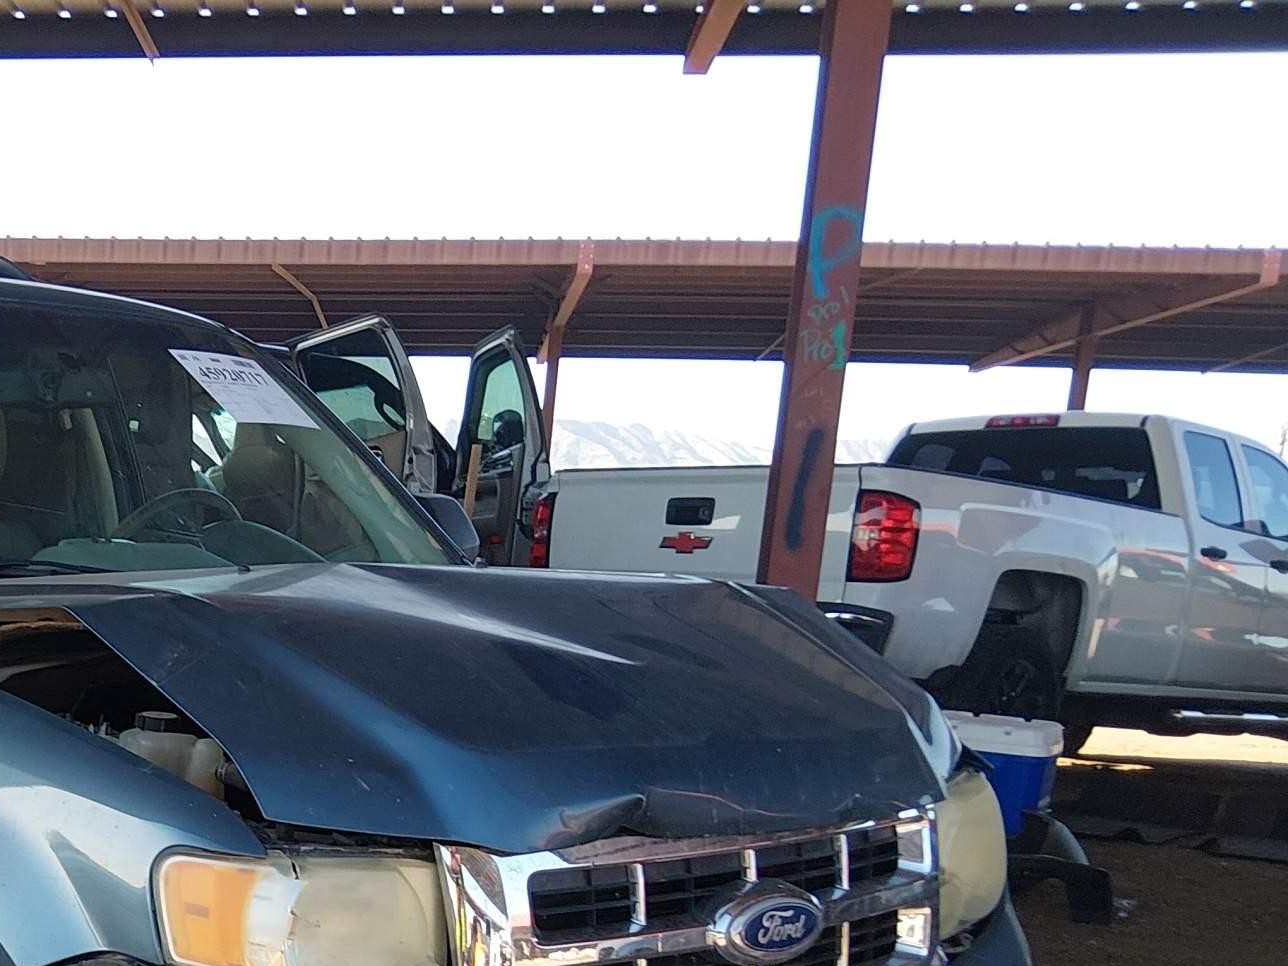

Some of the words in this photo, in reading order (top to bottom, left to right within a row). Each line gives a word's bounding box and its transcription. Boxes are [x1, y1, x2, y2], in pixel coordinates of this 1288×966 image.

[808, 204, 863, 299] P
[198, 366, 270, 386] 45920717
[757, 909, 807, 944] Ford
